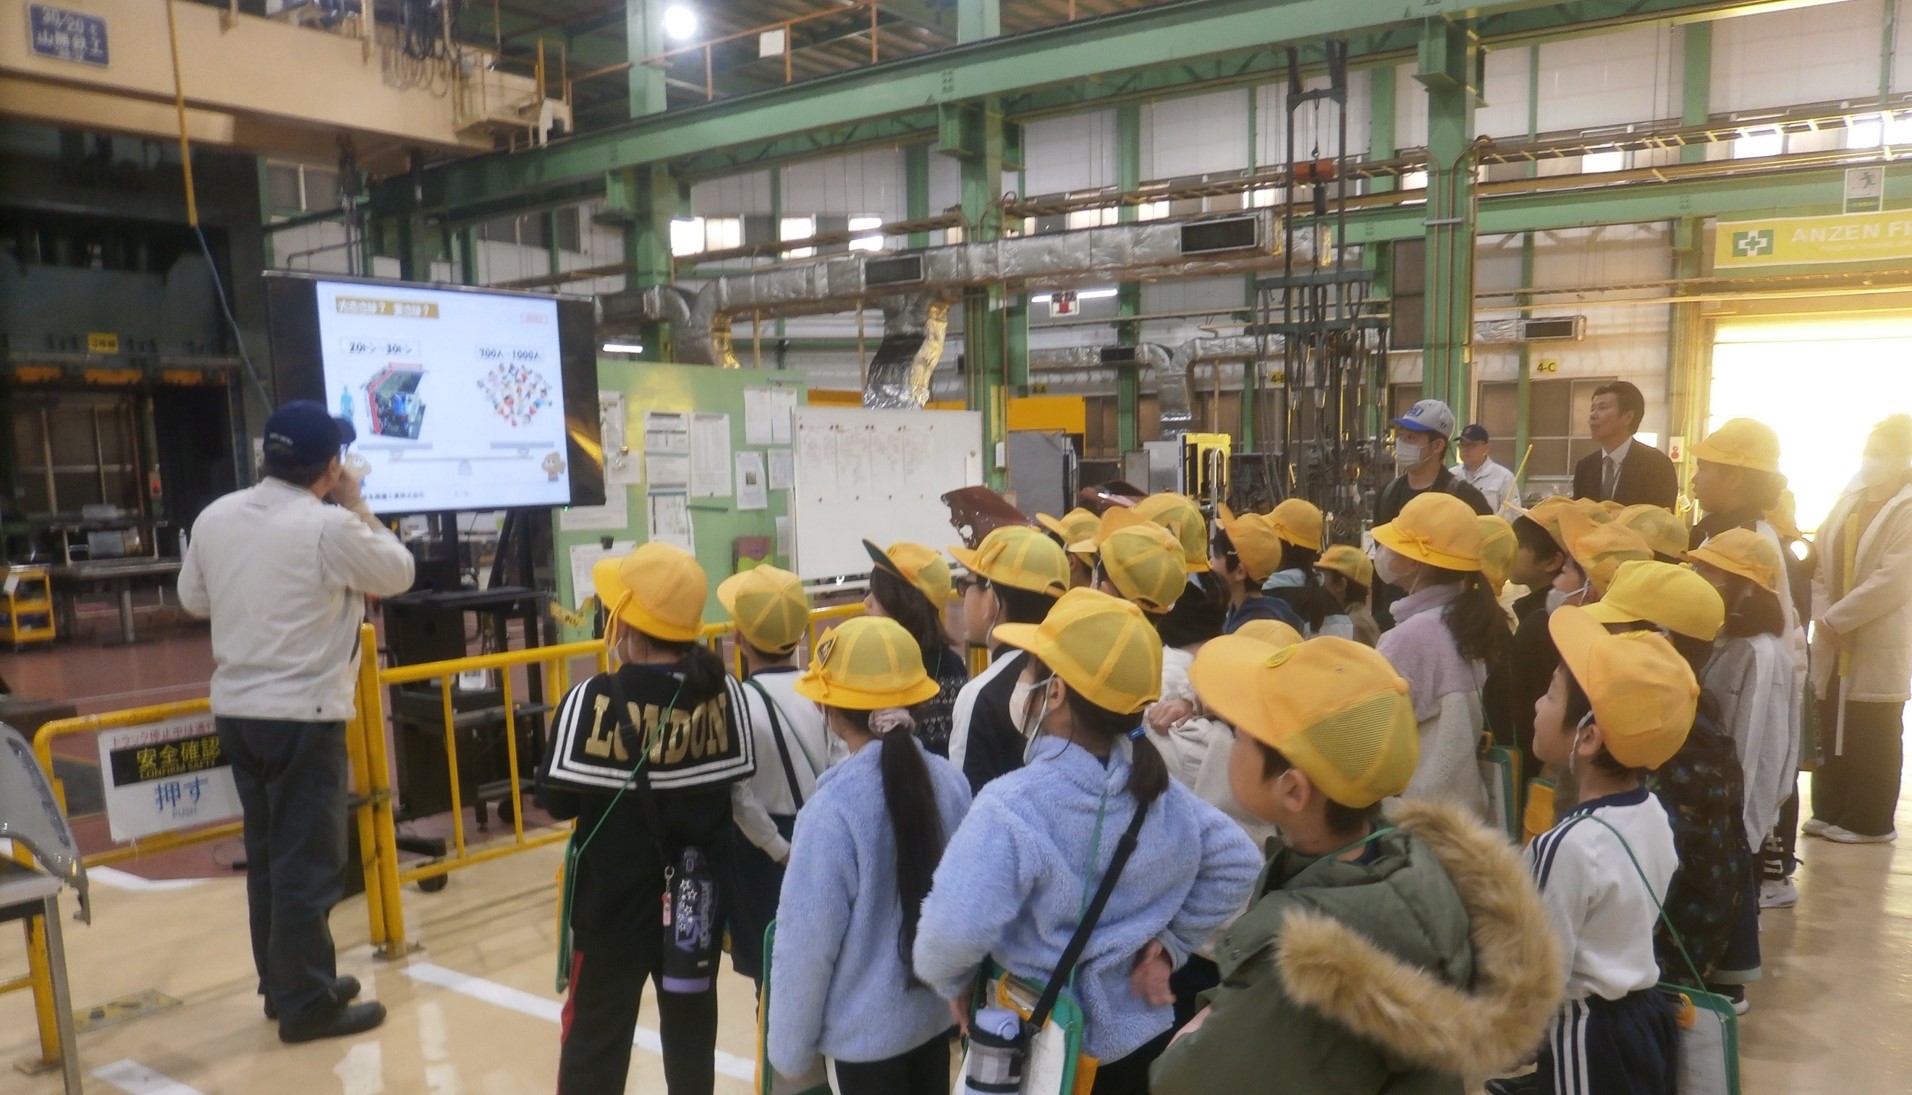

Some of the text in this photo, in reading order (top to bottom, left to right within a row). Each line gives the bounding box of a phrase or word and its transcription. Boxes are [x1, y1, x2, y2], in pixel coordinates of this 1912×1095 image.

[1791, 223, 1881, 244] ANZEN
[1536, 362, 1556, 373] 4-C
[584, 692, 729, 765] LONDON
[136, 736, 221, 770] 安全確認
[154, 775, 209, 812] 押す
